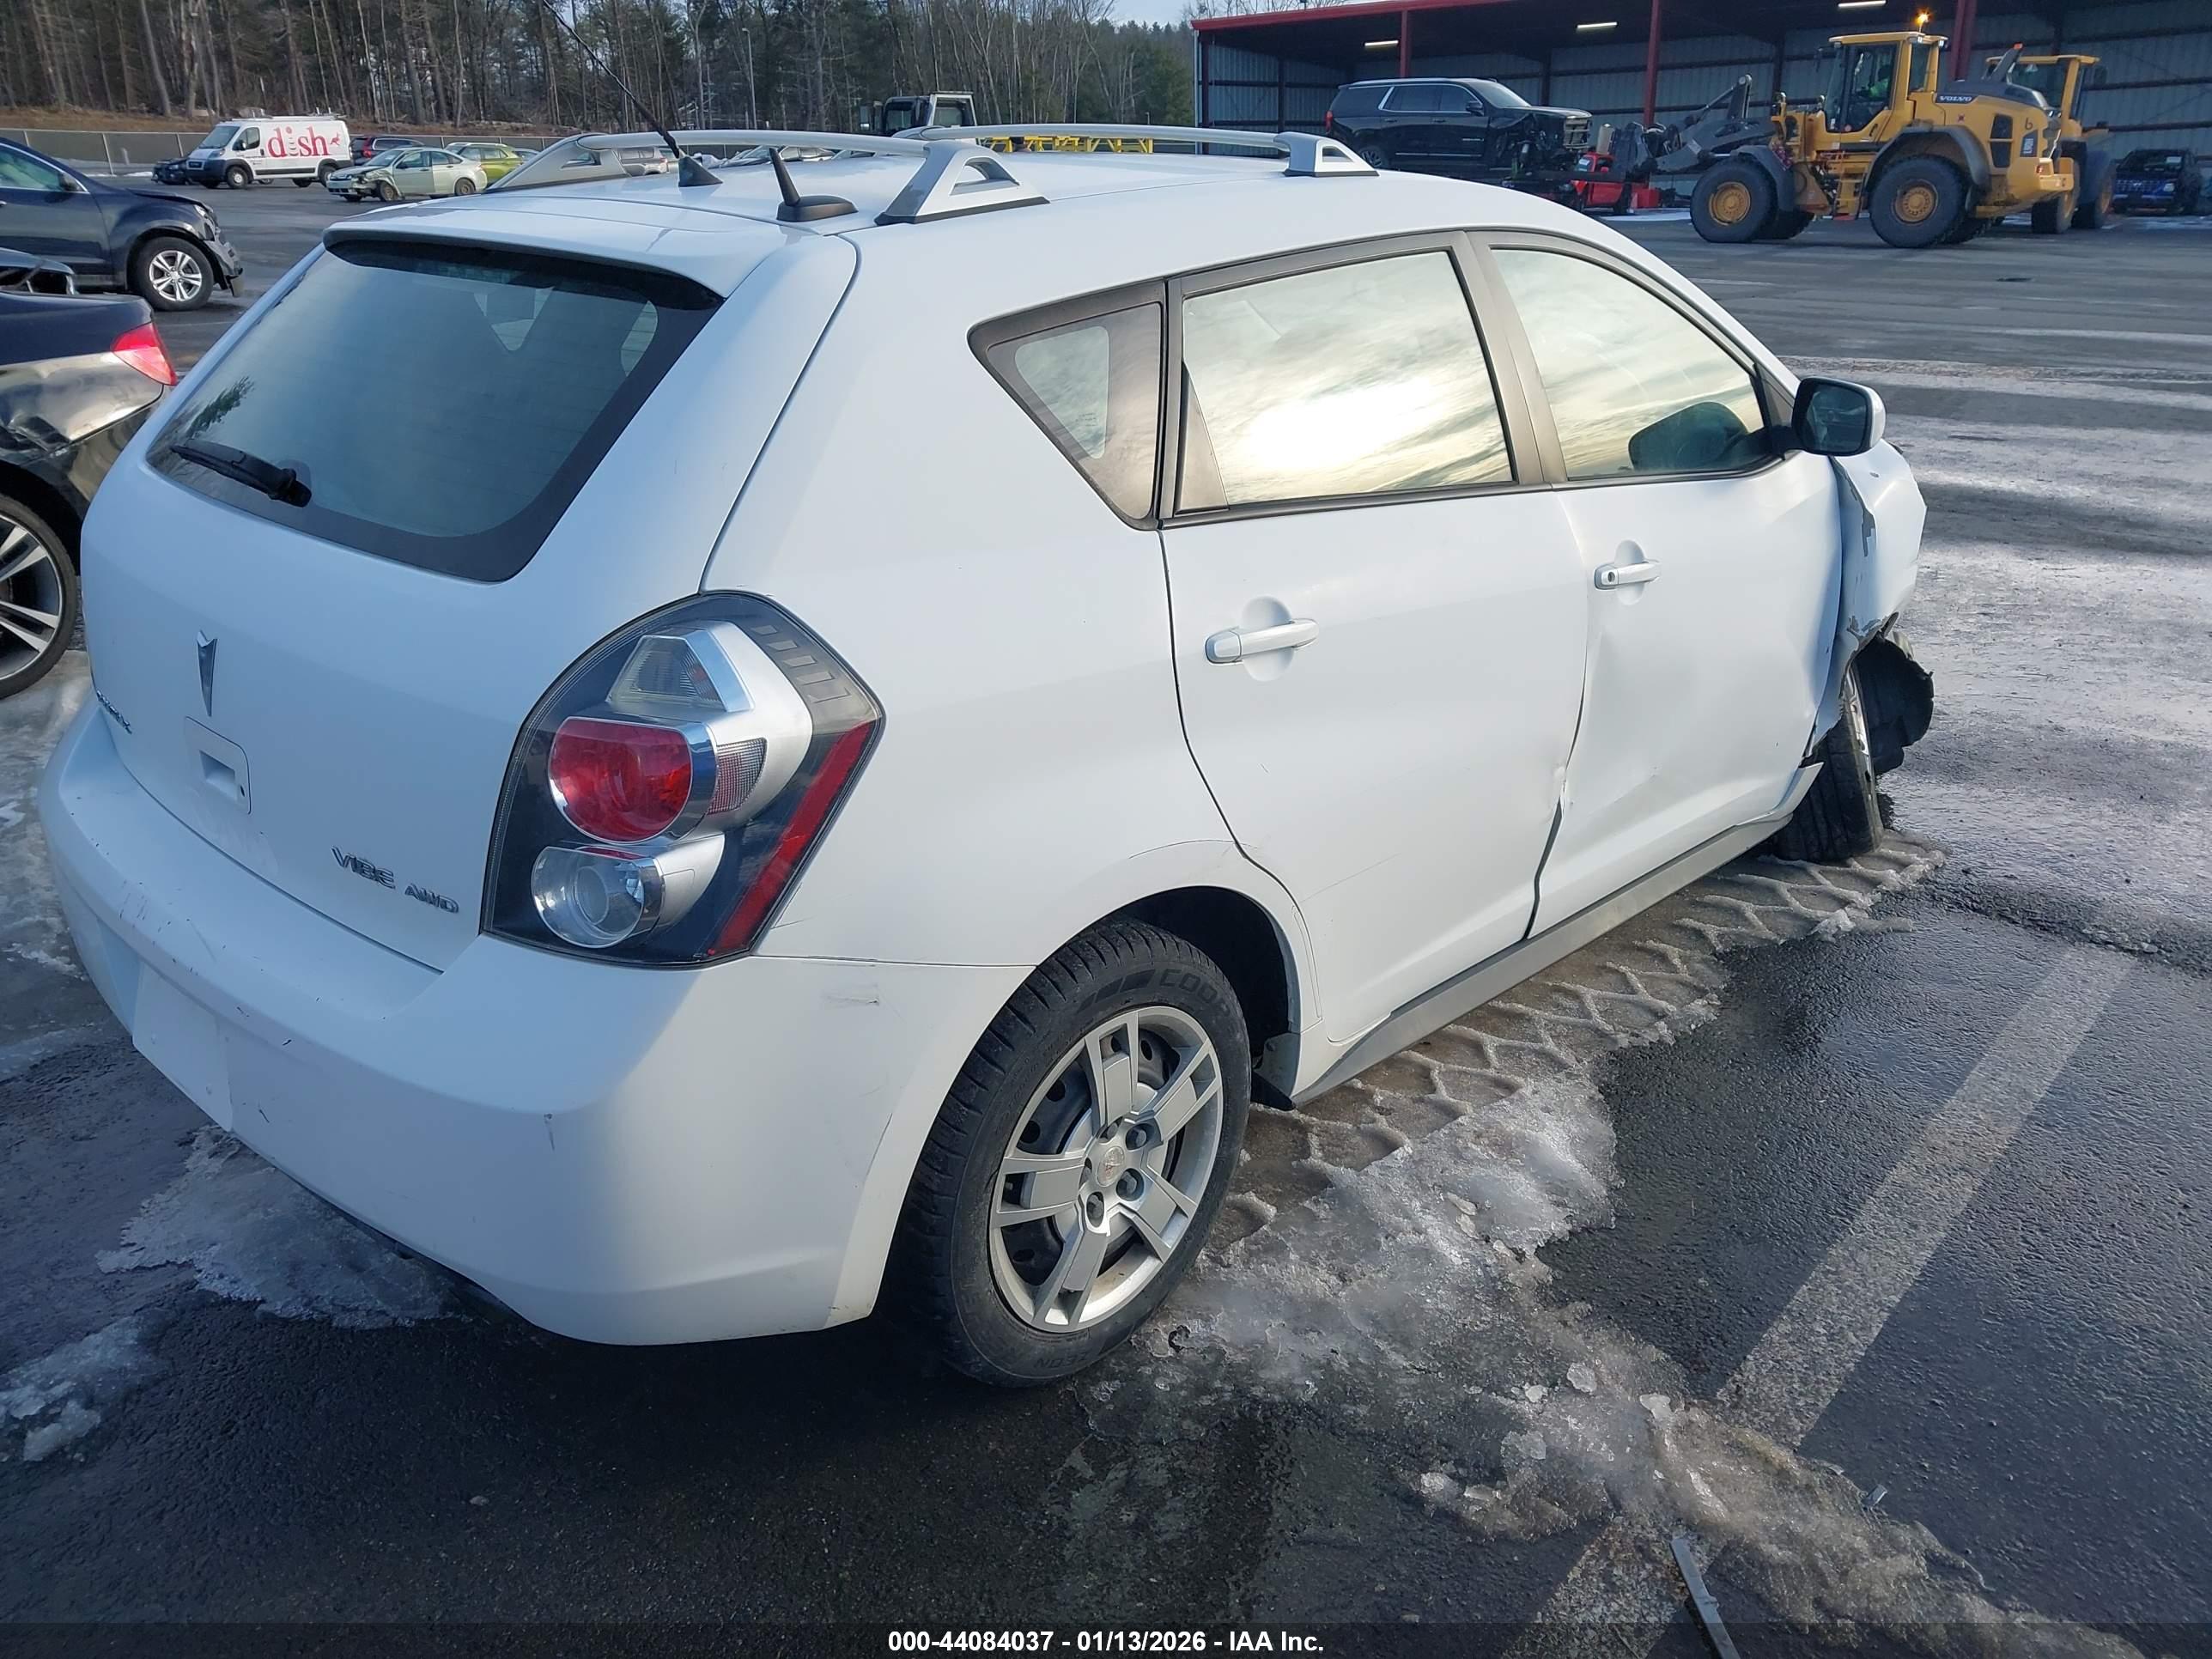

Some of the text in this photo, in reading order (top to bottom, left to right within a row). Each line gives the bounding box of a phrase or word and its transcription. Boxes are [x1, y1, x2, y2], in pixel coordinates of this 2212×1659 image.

[267, 125, 331, 158] dish
[331, 846, 459, 914] VIBE AWD
